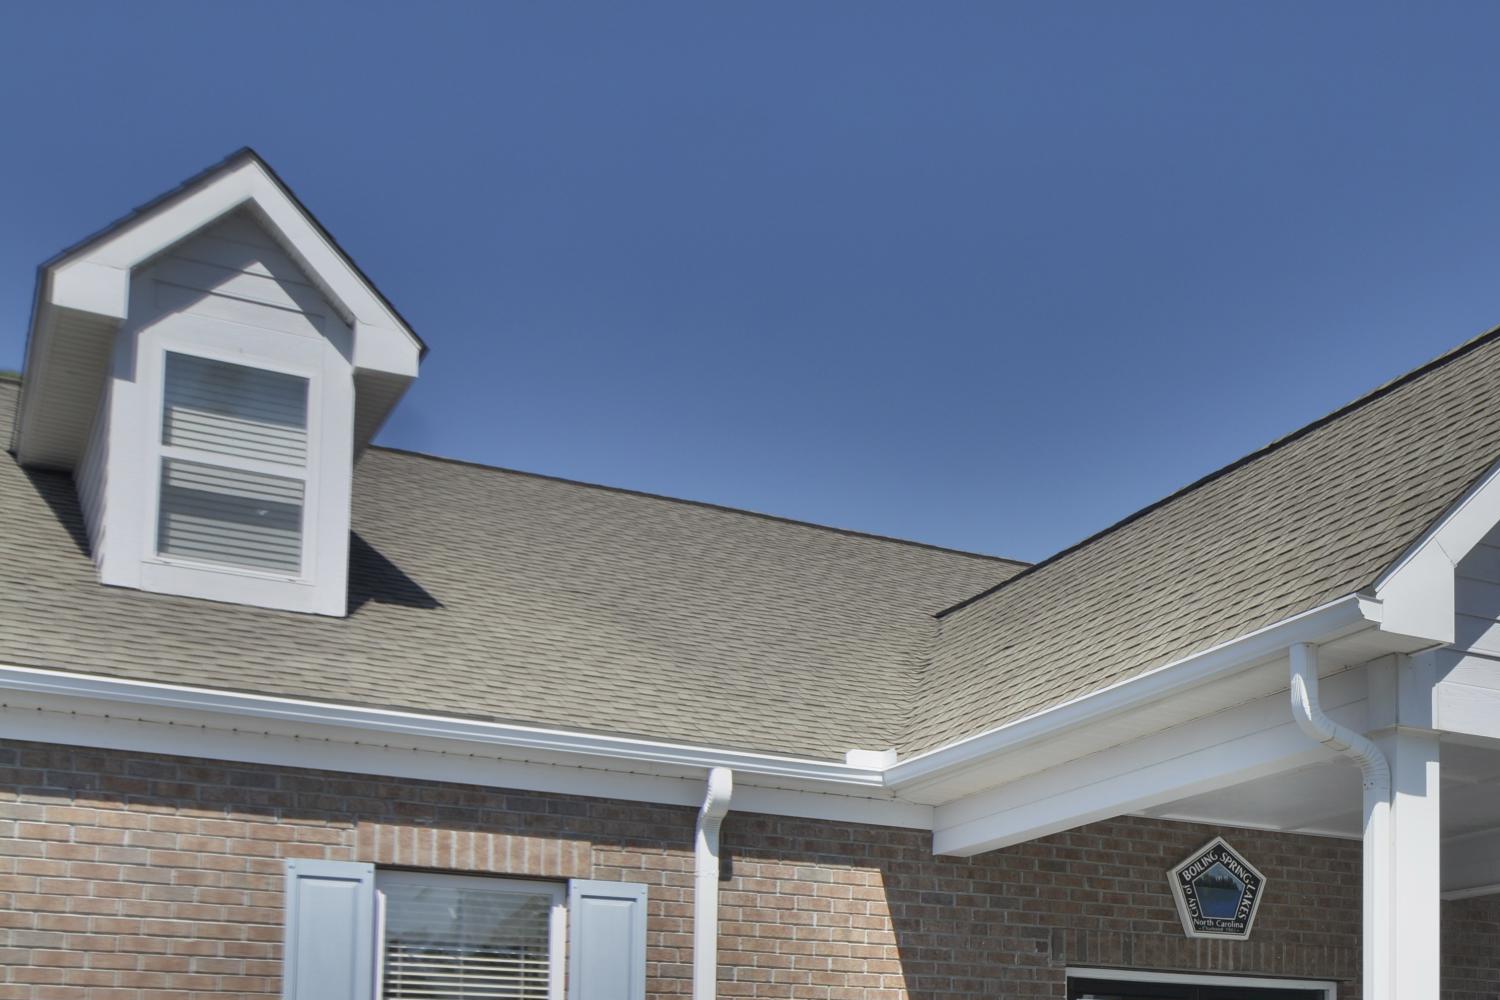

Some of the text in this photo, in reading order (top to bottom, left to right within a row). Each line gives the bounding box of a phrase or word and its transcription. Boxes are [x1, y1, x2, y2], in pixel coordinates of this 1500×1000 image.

[1182, 850, 1256, 920] City of BOILING SPRING LAKES
[1193, 918, 1214, 927] North
[1215, 920, 1244, 929] Carolina
